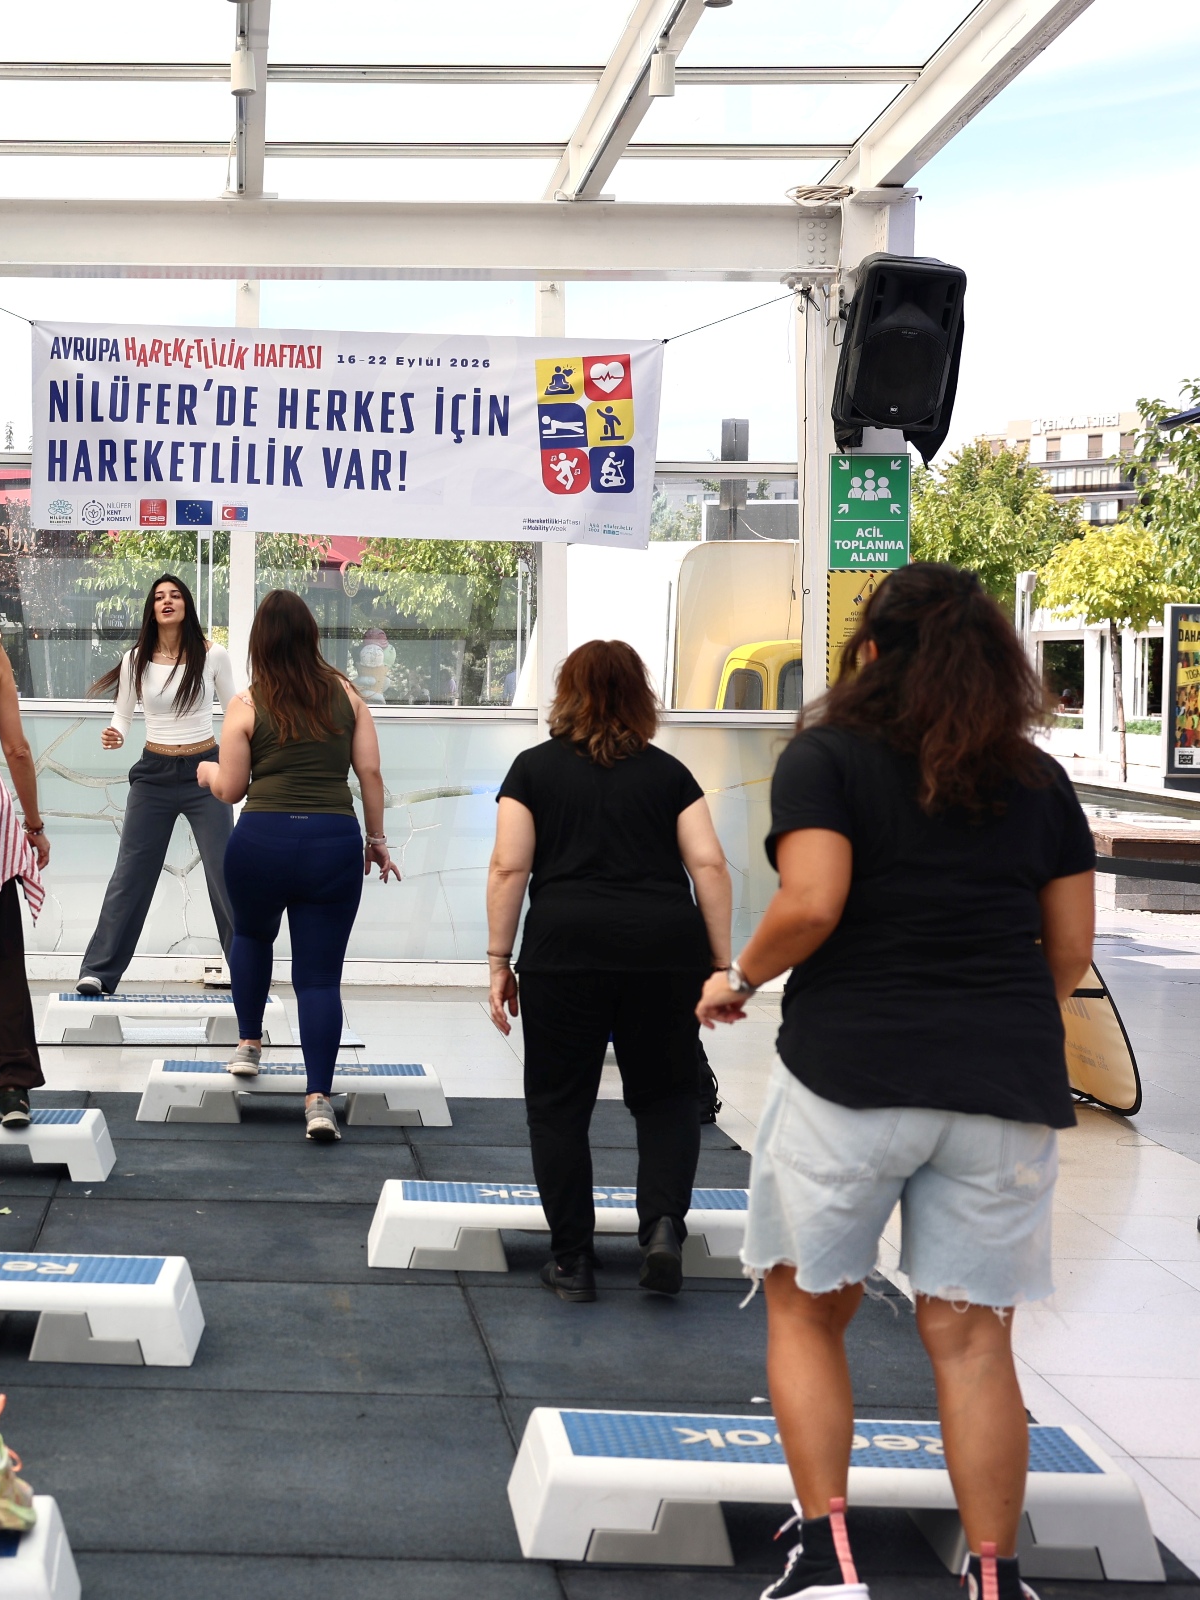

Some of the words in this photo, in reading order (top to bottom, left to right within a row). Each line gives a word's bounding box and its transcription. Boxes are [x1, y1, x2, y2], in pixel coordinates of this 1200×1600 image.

[50, 336, 121, 362] AVRUPA
[124, 336, 249, 370] HAREKETLİLİK
[253, 343, 322, 369] HAFTASI
[337, 354, 387, 365] 16-22
[396, 356, 441, 368] Eylül
[450, 358, 491, 368] 2026
[49, 373, 259, 427] NİLÜFER'DE
[278, 387, 415, 434] HERKES
[434, 386, 510, 443] İÇİN
[48, 436, 304, 487] HAREKETLİLİK
[322, 446, 407, 491] VAR!
[855, 525, 884, 538] ACİL
[834, 540, 905, 550] TOPLANMA
[850, 553, 889, 562] ALANI
[1178, 629, 1200, 643] DAHA
